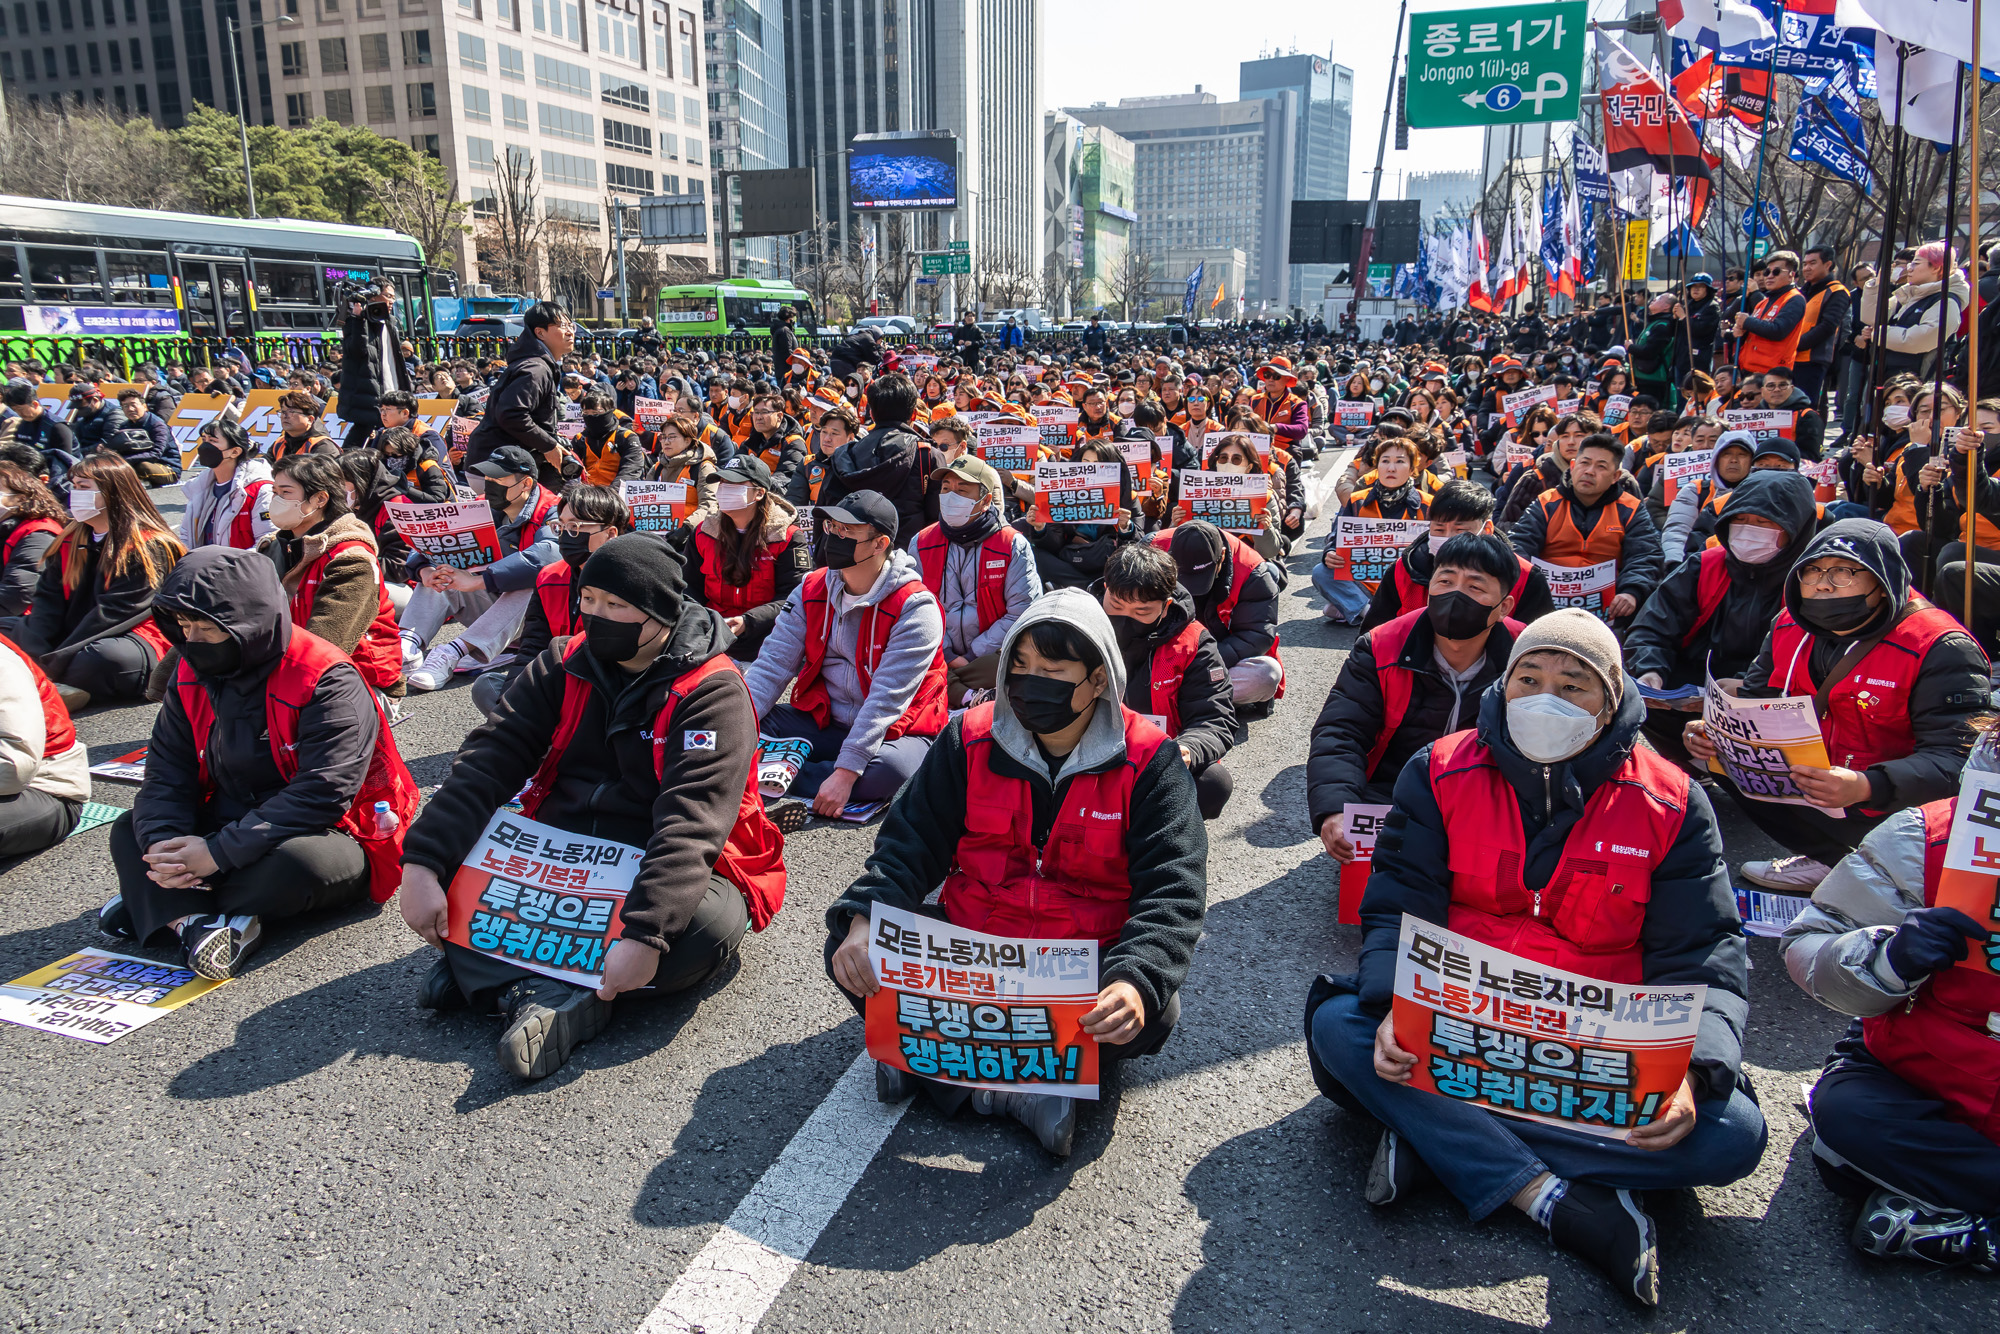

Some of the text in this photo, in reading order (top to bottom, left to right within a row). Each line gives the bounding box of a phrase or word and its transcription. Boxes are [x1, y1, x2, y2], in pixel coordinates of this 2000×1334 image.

[1423, 15, 1566, 57] 종로1가
[1420, 60, 1530, 84] Jongno 1(il)-ga
[1497, 89, 1510, 107] 6
[1727, 414, 1742, 422] 모든
[1744, 412, 1774, 420] 노동자의
[980, 427, 1021, 437] 모든 노동자의
[1040, 424, 1067, 435] 쟁으로
[981, 437, 1012, 446] 노동기본권
[1040, 436, 1072, 445] 취하자!
[985, 446, 1026, 458] 투쟁으로
[1667, 458, 1687, 467] 모든
[1038, 467, 1058, 478] 모든
[1060, 465, 1096, 477] 노동자의
[1041, 478, 1085, 490] 노동기본권
[1183, 475, 1202, 487] 모든
[1205, 476, 1243, 486] 노동자의
[627, 485, 637, 494] 모든
[639, 484, 666, 494] 노동자의
[1185, 488, 1231, 498] 노동기본권
[628, 494, 656, 504] 노동기본권
[1049, 488, 1104, 506] 투쟁으로
[390, 508, 413, 521] 모든
[414, 505, 459, 521] 노동자의
[634, 504, 671, 518] 투쟁으로
[1050, 504, 1114, 522] 쟁취하자!
[1192, 500, 1250, 514] 투쟁으로
[399, 520, 449, 534] 노동기본권
[634, 518, 679, 530] 쟁취하자!
[1341, 522, 1363, 534] 모든
[1366, 522, 1407, 533] 노동자의
[411, 532, 479, 553] 투쟁으로
[1344, 534, 1394, 545] 노동기본권
[1552, 568, 1594, 582] 노동자의
[1549, 583, 1581, 594] 기본권
[1772, 702, 1805, 710] 민주노총
[1708, 705, 1762, 739] 나와라!
[488, 820, 625, 867] 모든 노동자의
[480, 848, 590, 890] 노동기본권
[482, 877, 614, 932] 투쟁으로
[876, 918, 1090, 969] 모든 노동자의 민주노총
[58, 956, 199, 988] 쟁취하자!
[880, 958, 996, 997] 노동기본권
[1407, 933, 1695, 1011] 모든 노동자의 민주노총
[45, 972, 174, 1005] 원청교섭
[26, 993, 118, 1016] 나와라!
[1412, 973, 1568, 1036] 노동기본권
[898, 993, 1052, 1040] 투쟁으로
[1432, 1013, 1631, 1086] 투쟁으로
[902, 1036, 1080, 1081] 쟁취하자!
[1431, 1055, 1660, 1125] 쟁취하자!
